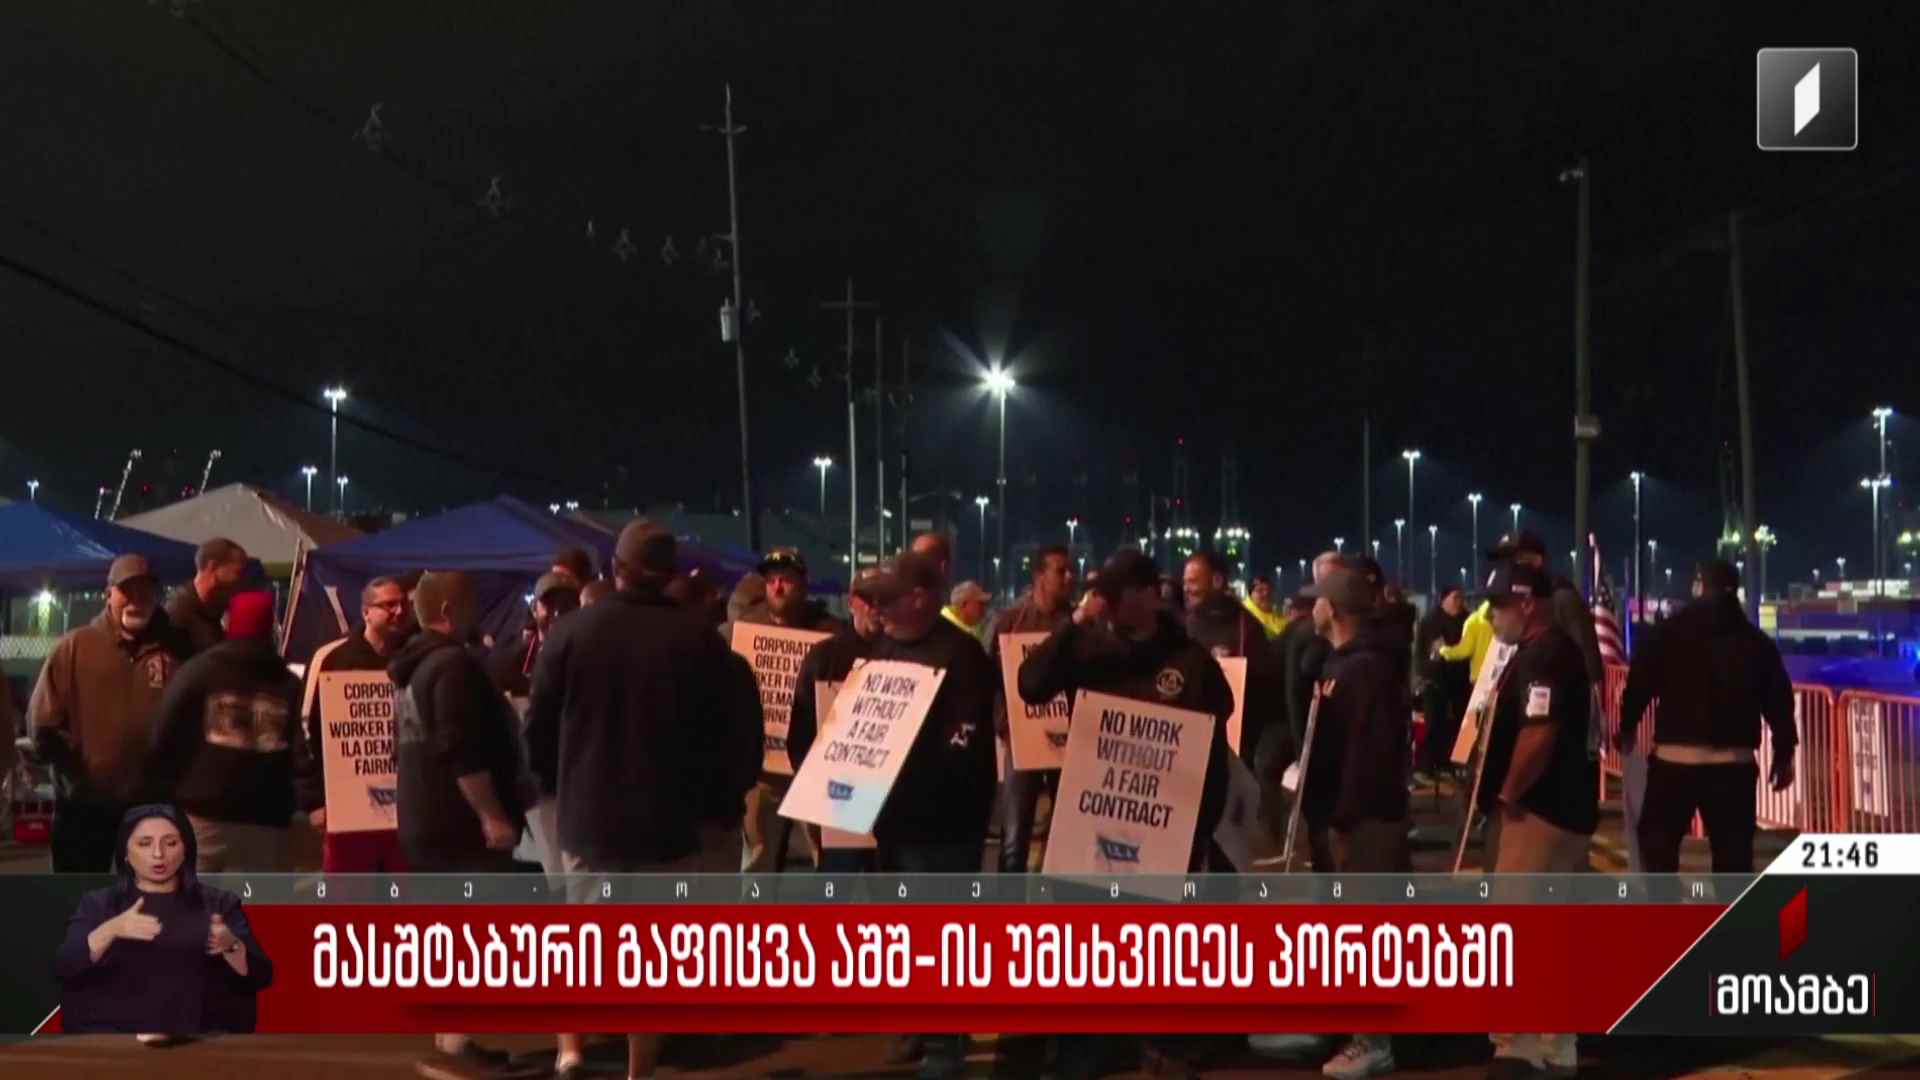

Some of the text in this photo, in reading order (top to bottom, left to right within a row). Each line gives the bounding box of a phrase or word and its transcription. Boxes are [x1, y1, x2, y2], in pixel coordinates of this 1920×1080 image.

[753, 635, 812, 656] CORPORAT
[755, 654, 791, 672] GREED
[862, 673, 919, 698] NO WORK
[350, 702, 391, 719] GREED
[852, 695, 909, 720] WITHOUT
[330, 720, 385, 739] WORKER
[848, 720, 890, 743] A FAIR
[1100, 709, 1183, 747] NO WORK
[341, 739, 361, 758] ILA
[823, 740, 891, 768] CONTRACT
[1096, 735, 1179, 772] WITHOUT
[1102, 766, 1160, 799] A FAIR
[1078, 789, 1174, 829] CONTRACT
